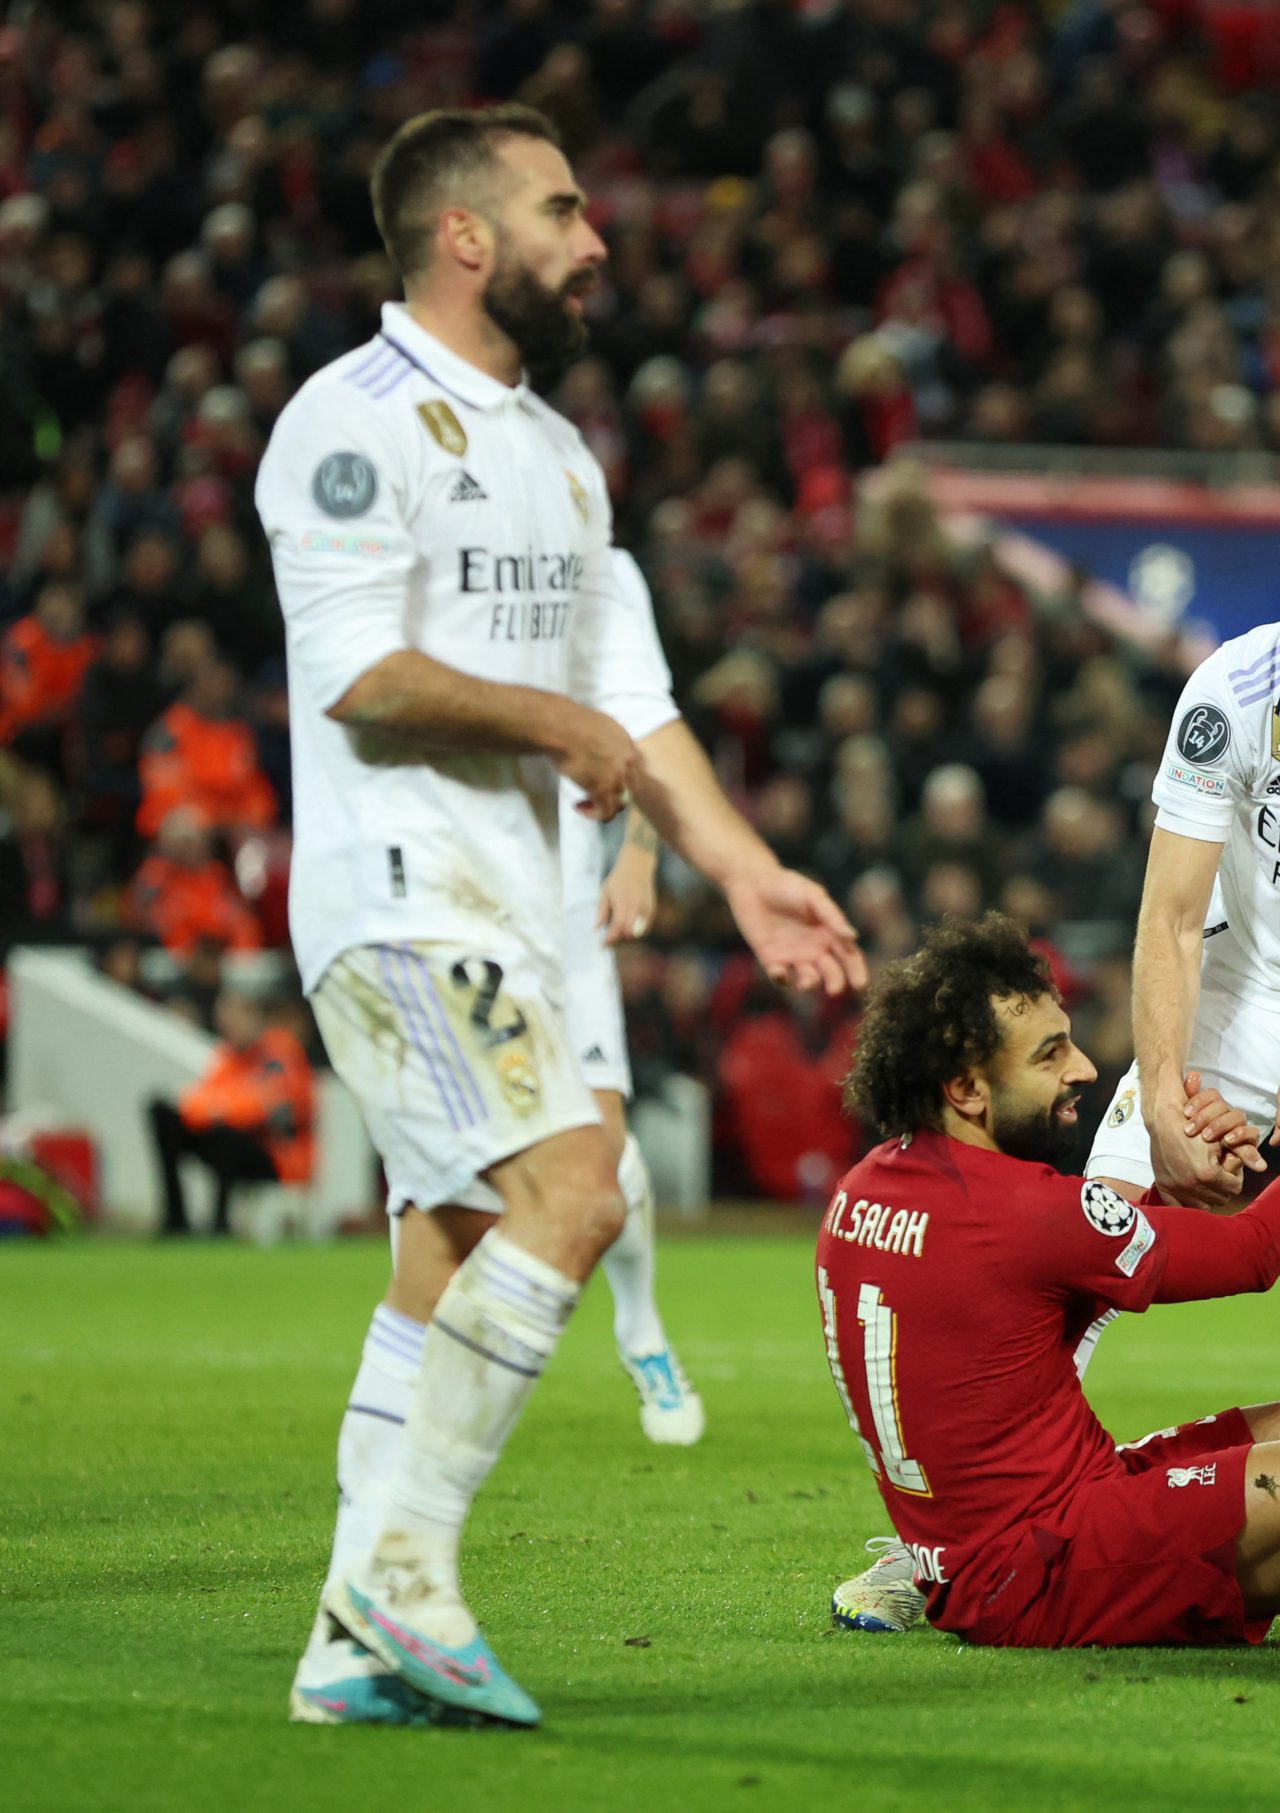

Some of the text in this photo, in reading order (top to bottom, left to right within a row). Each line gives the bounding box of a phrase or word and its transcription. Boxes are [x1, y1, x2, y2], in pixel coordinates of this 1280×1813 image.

[458, 543, 584, 592] Emirate
[489, 602, 570, 640] FL BETT
[1188, 730, 1205, 749] 14
[452, 957, 527, 1047] 2
